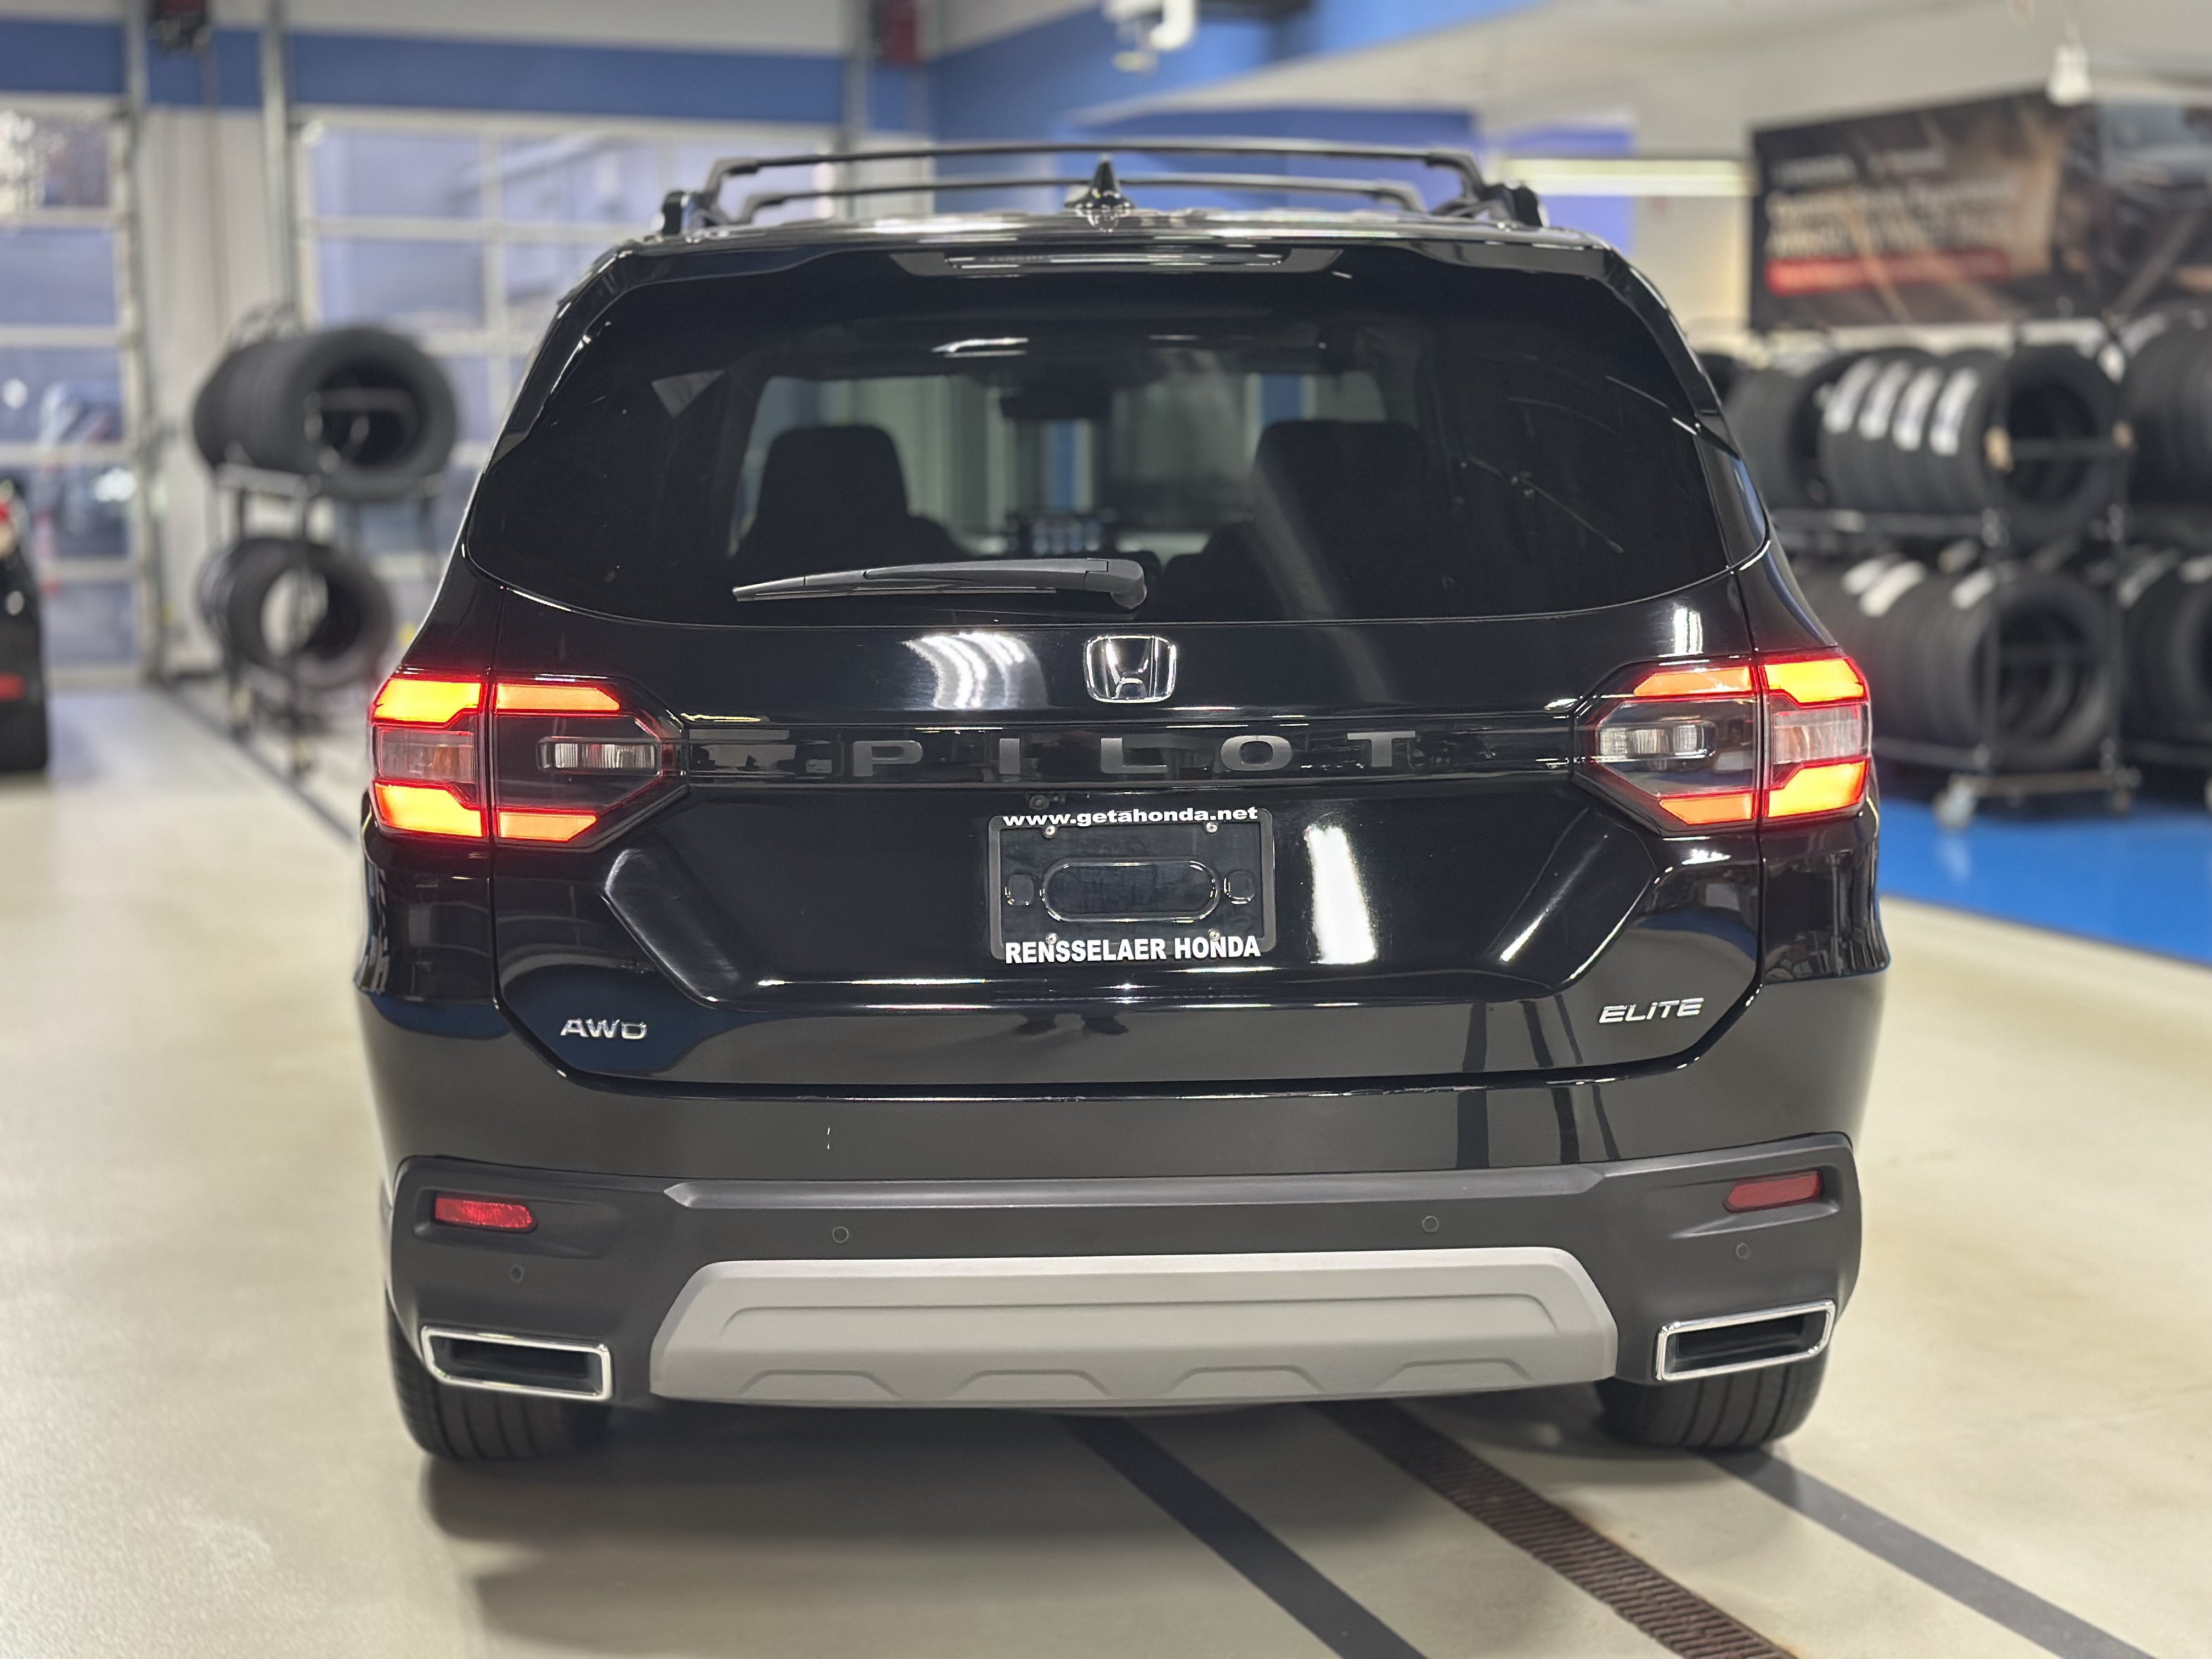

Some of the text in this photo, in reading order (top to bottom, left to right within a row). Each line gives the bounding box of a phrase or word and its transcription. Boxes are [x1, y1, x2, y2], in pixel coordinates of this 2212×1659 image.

[854, 730, 1415, 776] PILOT
[1003, 807, 1258, 827] www.getahonda.net
[1006, 936, 1261, 964] RENSSELAER HONDA
[1599, 997, 1704, 1023] ELITE
[560, 1018, 647, 1039] AWD
